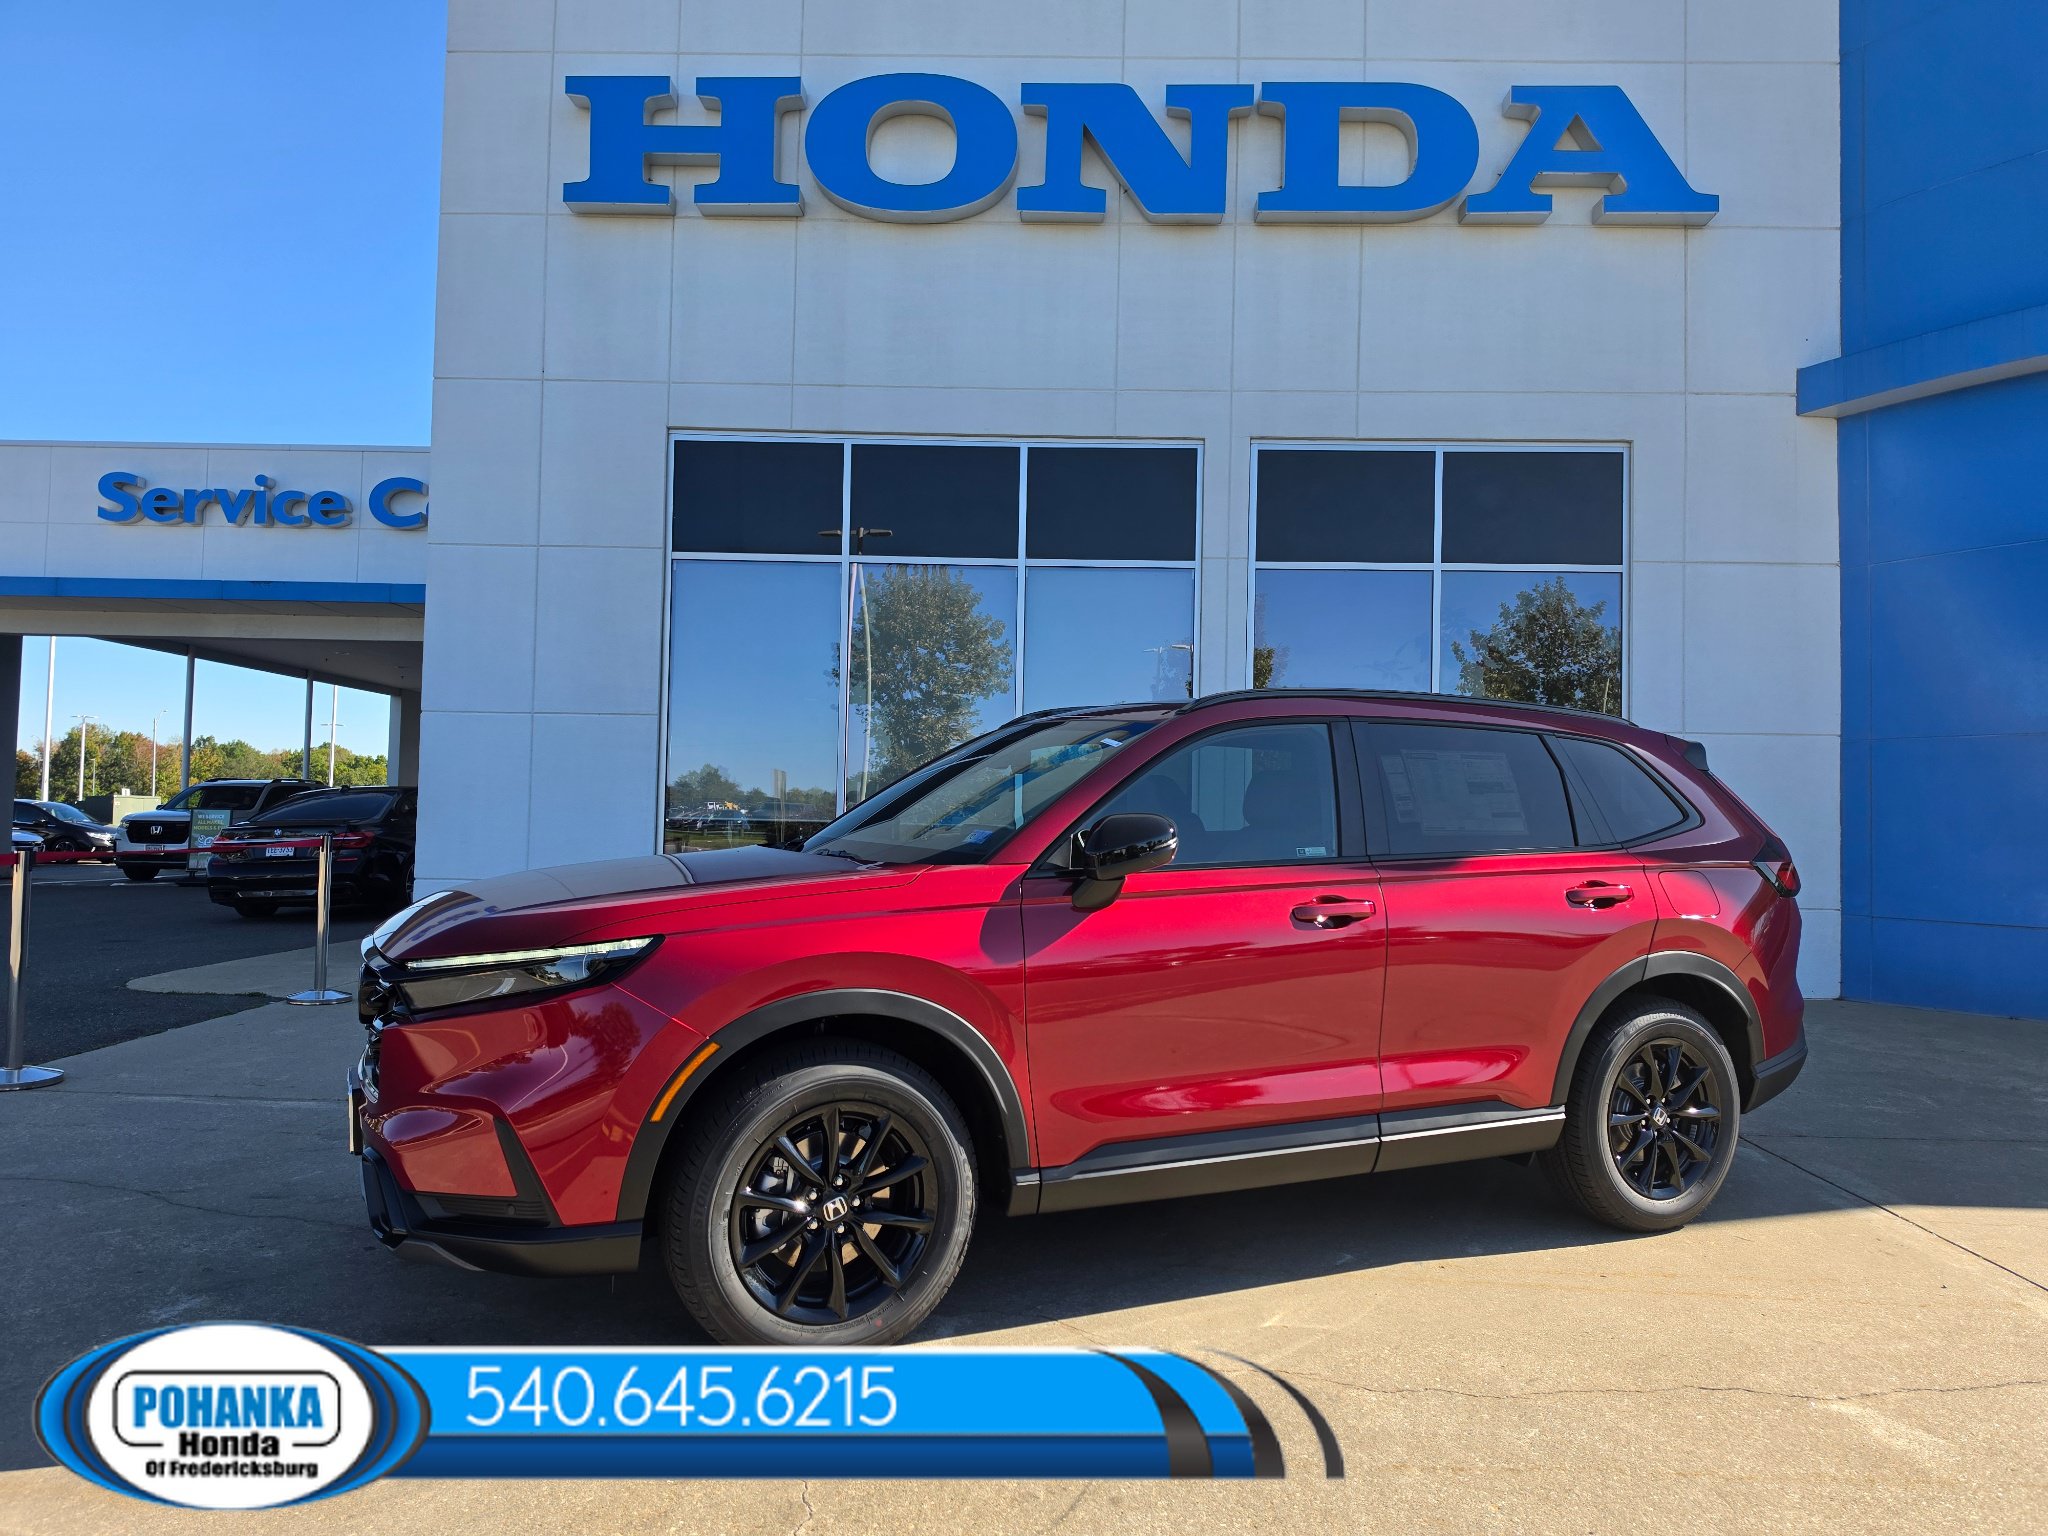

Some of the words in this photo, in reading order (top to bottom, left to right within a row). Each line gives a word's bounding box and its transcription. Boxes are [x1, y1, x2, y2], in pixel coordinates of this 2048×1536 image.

[562, 72, 1720, 224] HONDA
[97, 471, 352, 527] Service
[368, 476, 428, 530] C
